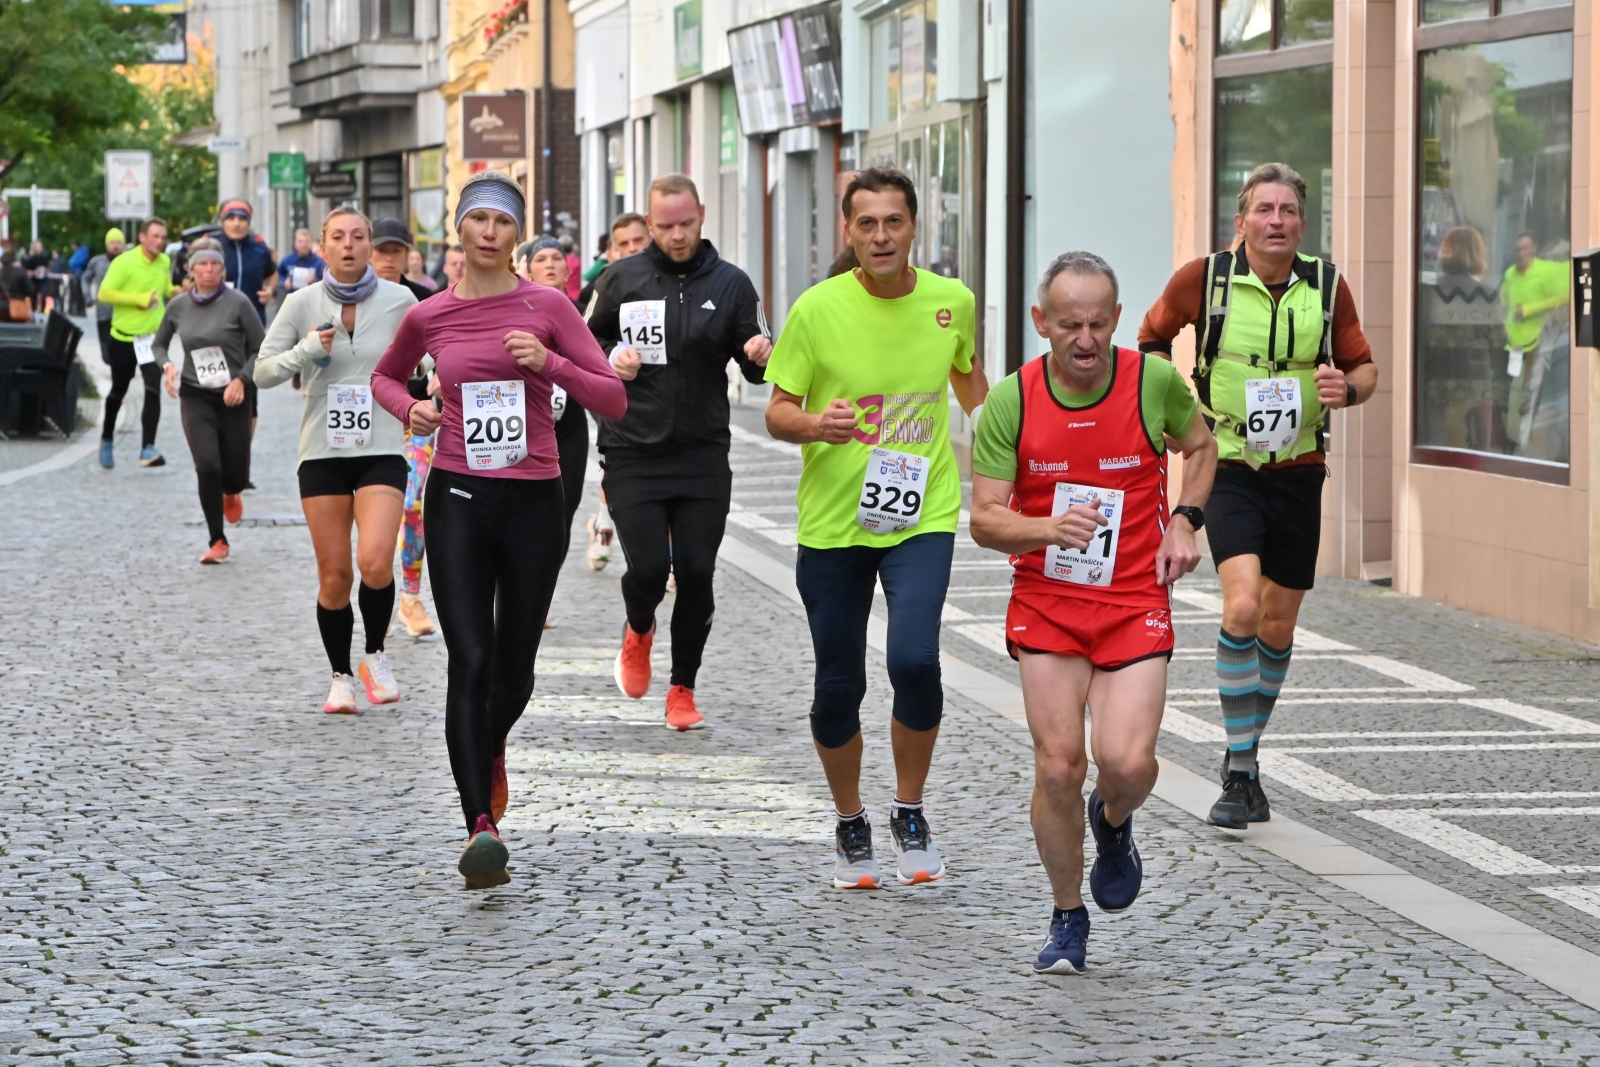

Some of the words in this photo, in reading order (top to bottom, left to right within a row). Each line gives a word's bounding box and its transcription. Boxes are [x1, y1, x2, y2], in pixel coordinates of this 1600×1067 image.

[623, 326, 663, 345] 145
[198, 361, 226, 378] 264
[903, 406, 919, 418] PRO
[328, 410, 370, 430] 336
[1248, 409, 1296, 433] 671
[465, 415, 524, 444] 209
[493, 443, 522, 452] KOLISKOVÁ
[1028, 459, 1068, 472] Krakonoš
[1099, 454, 1140, 466] MARATON
[860, 482, 921, 516] 329
[866, 511, 887, 520] ONDŘEJ
[887, 516, 908, 524] PROKOP
[1056, 554, 1080, 563] MARTIN
[1081, 558, 1104, 567] VAŠÍČEK
[1054, 566, 1072, 575] CUP
